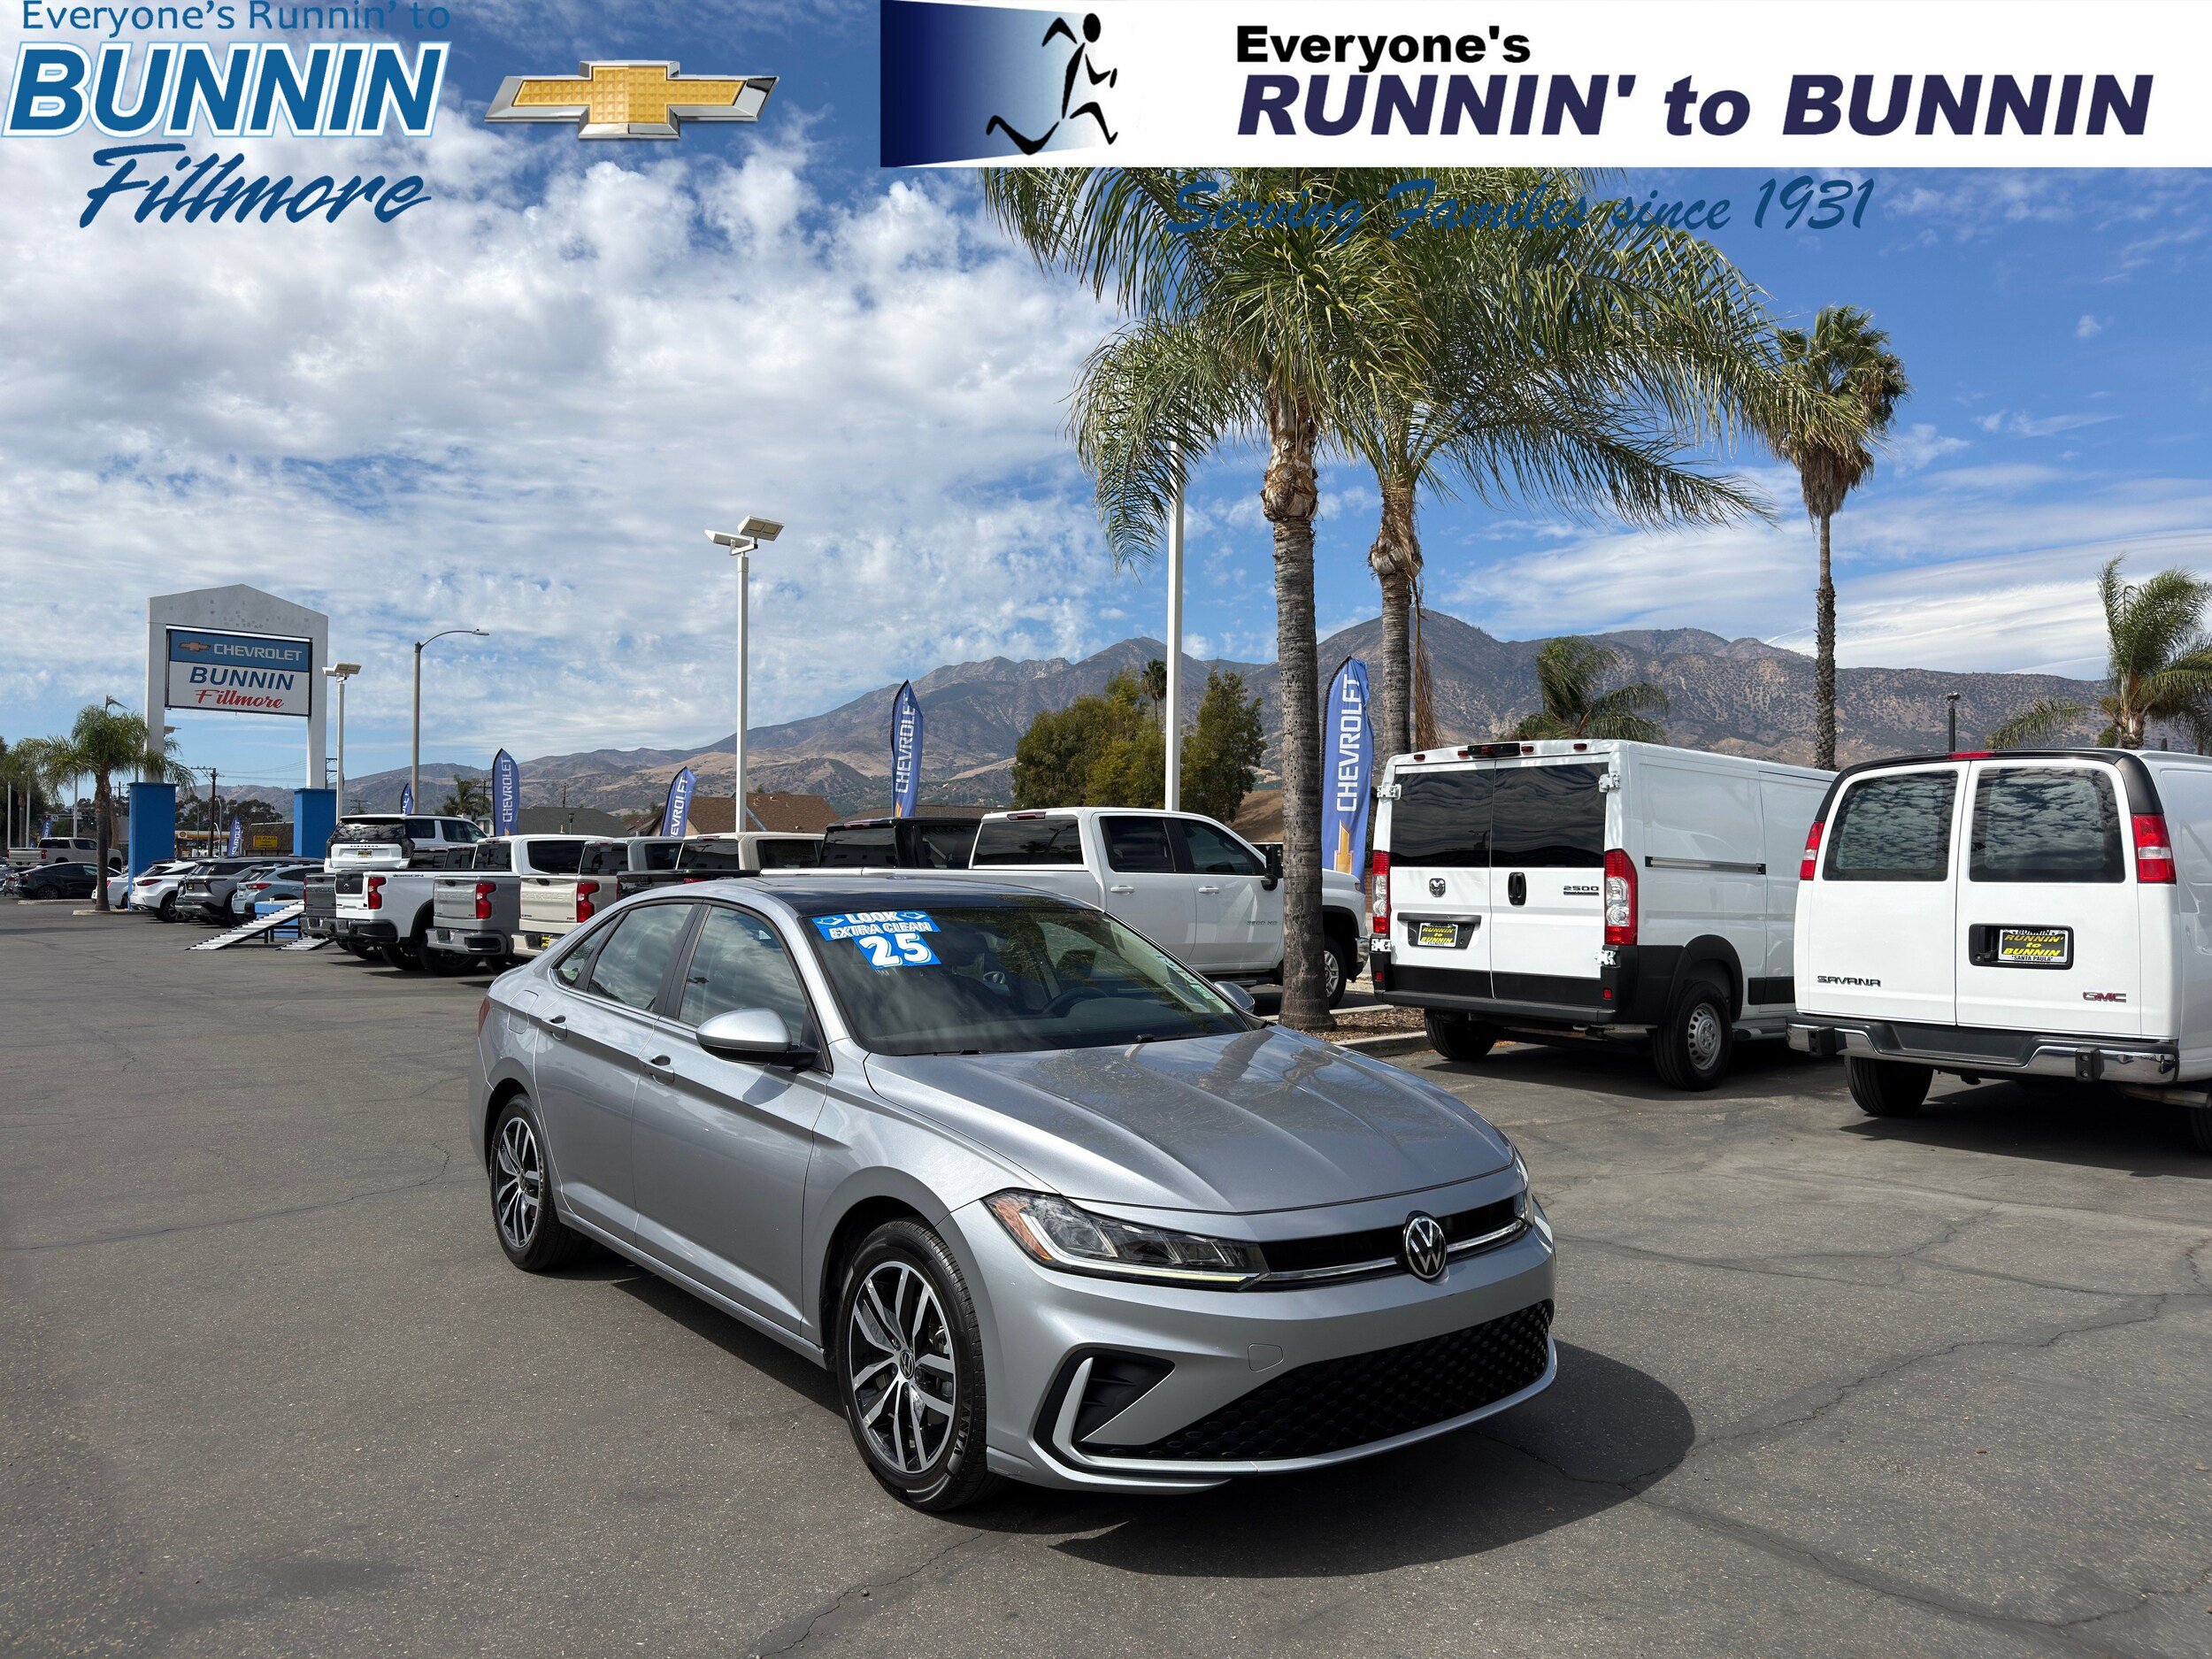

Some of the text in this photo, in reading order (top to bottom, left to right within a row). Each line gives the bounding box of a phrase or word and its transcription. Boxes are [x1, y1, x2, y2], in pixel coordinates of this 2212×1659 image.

[213, 643, 303, 662] CHEVROLET
[189, 666, 295, 690] BUNNIN
[195, 689, 284, 709] Fillmore
[1337, 673, 1363, 812] CHEVROLET
[500, 757, 513, 823] CHEVROLET
[670, 776, 688, 837] EVROLET
[844, 911, 903, 924] LOOK
[829, 921, 933, 940] EXTRA CLEAN
[859, 932, 932, 967] 25
[2003, 948, 2061, 956] BUNNIN
[1816, 975, 1882, 987] SAVANA
[2083, 991, 2127, 1003] GMC
